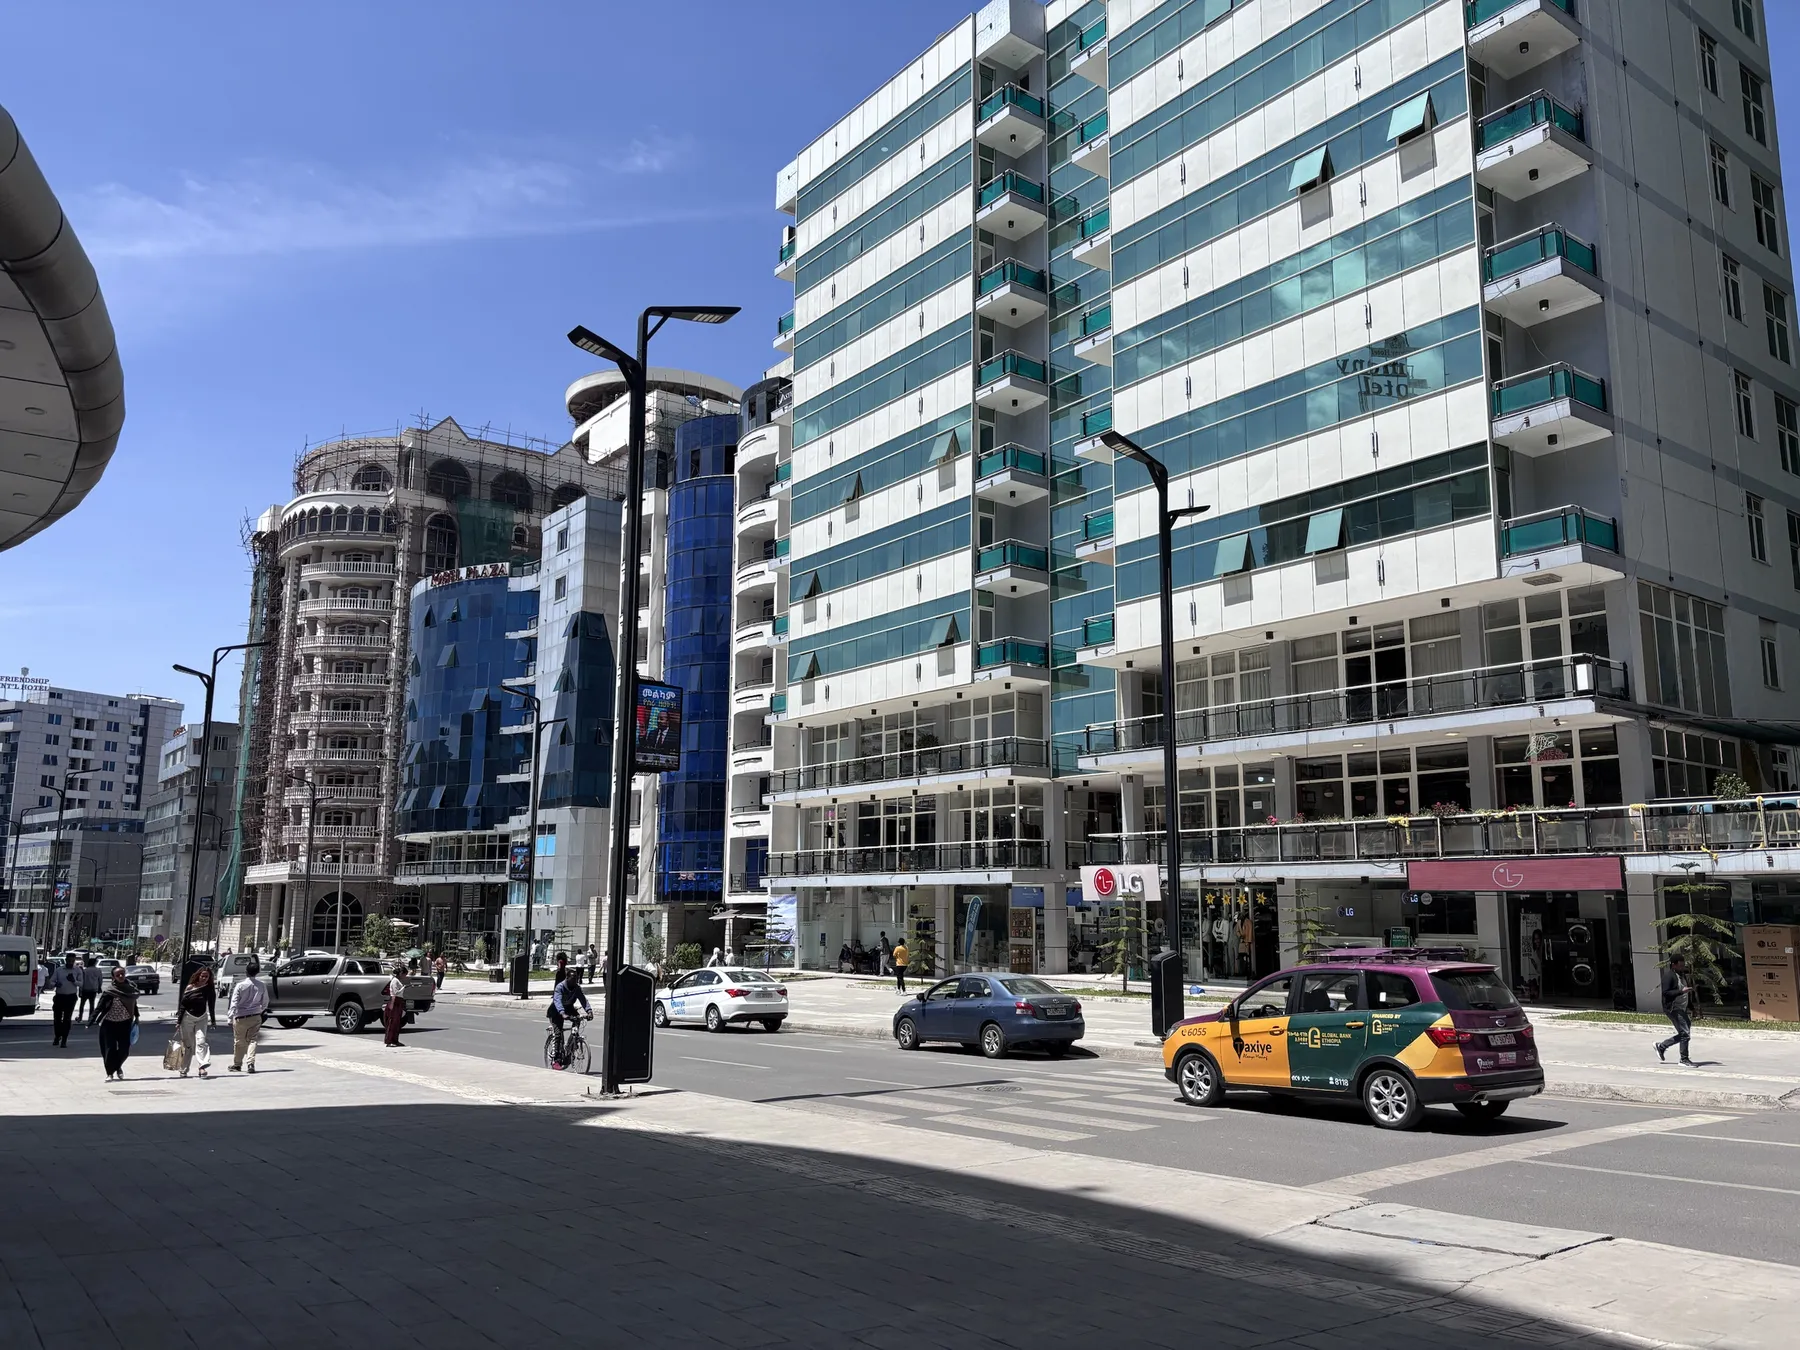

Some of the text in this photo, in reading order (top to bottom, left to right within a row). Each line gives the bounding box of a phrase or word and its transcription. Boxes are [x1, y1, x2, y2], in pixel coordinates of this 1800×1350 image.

[465, 564, 508, 580] PLAZA
[0, 676, 50, 684] FRIENDSHIP
[642, 688, 676, 699] መልካም
[1118, 873, 1143, 893] LG
[1345, 907, 1354, 916] LG
[1187, 1027, 1207, 1037] 6055
[1335, 1078, 1349, 1086] 8118
